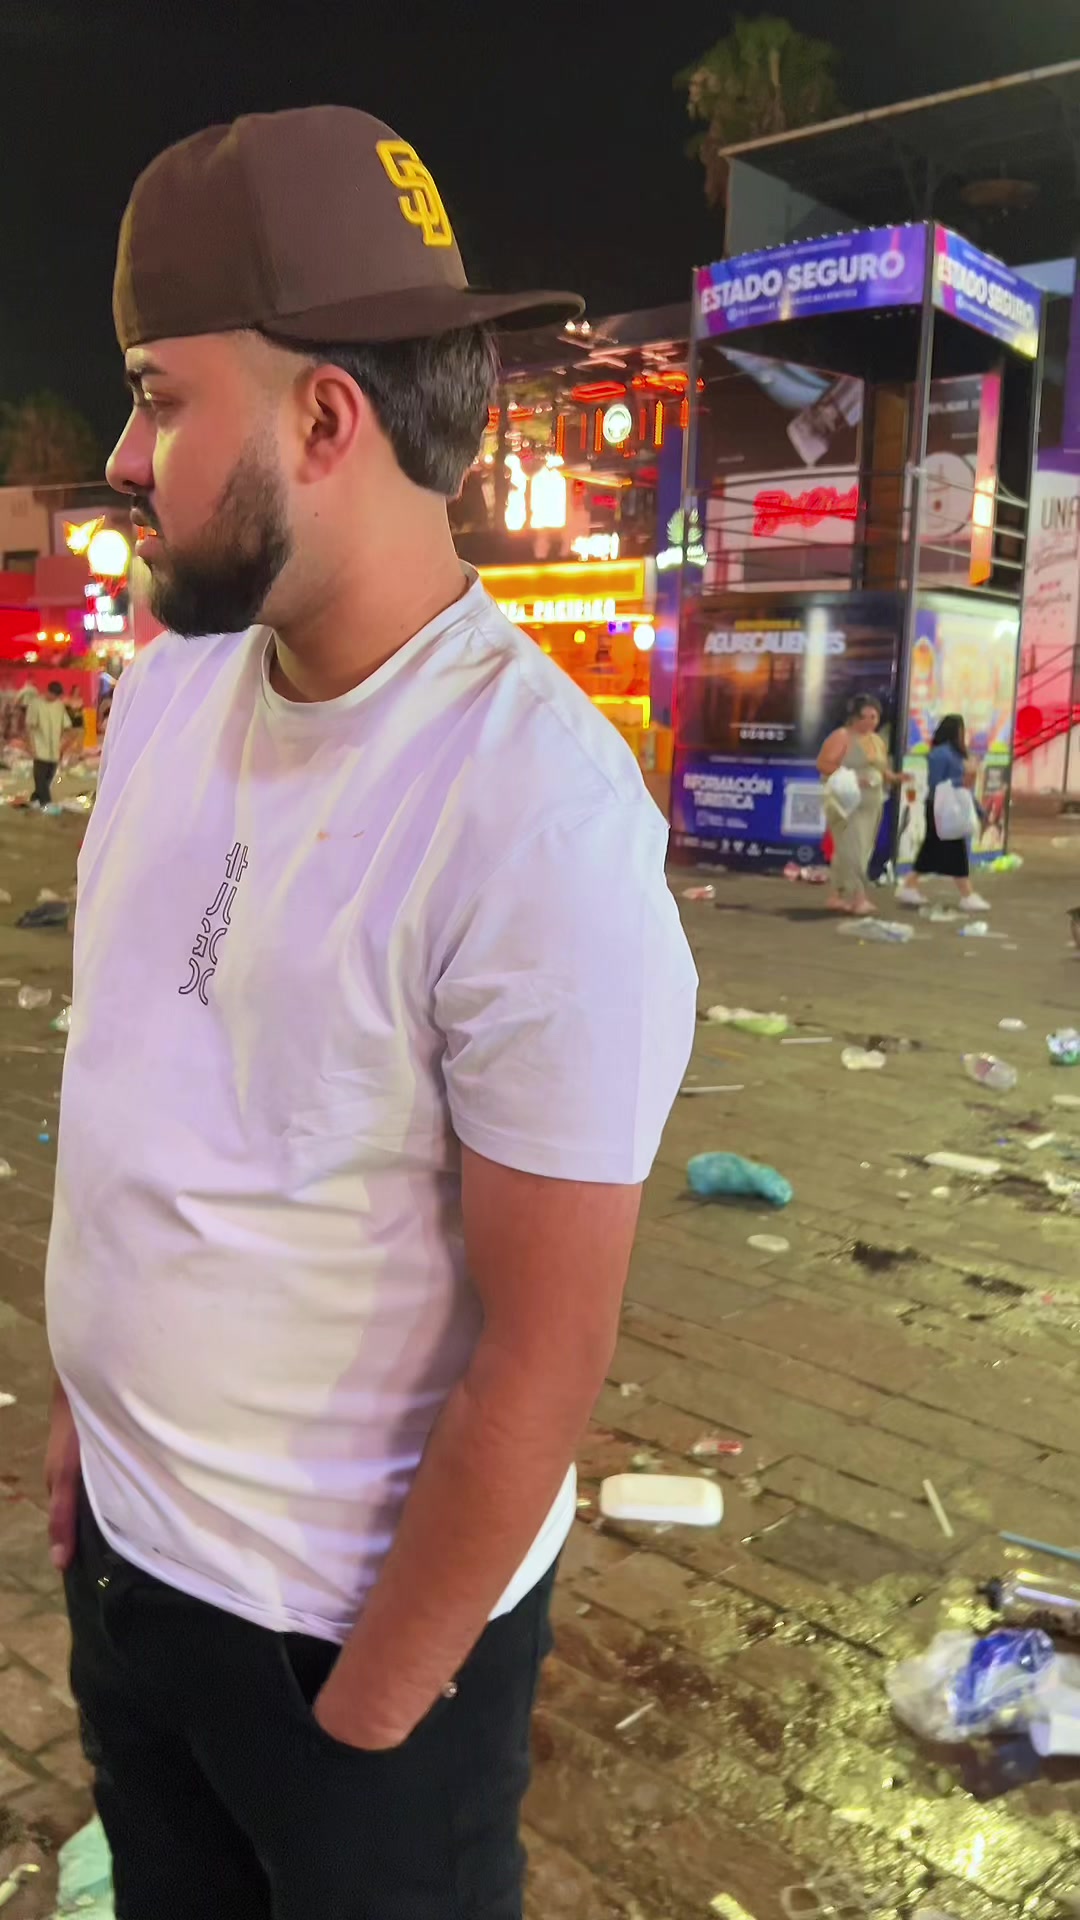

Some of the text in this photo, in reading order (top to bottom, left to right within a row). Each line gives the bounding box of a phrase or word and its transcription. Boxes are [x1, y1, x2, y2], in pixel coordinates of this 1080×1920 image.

[376, 140, 453, 247] SD
[701, 268, 784, 314] ESTADO
[788, 251, 905, 293] SEGURO
